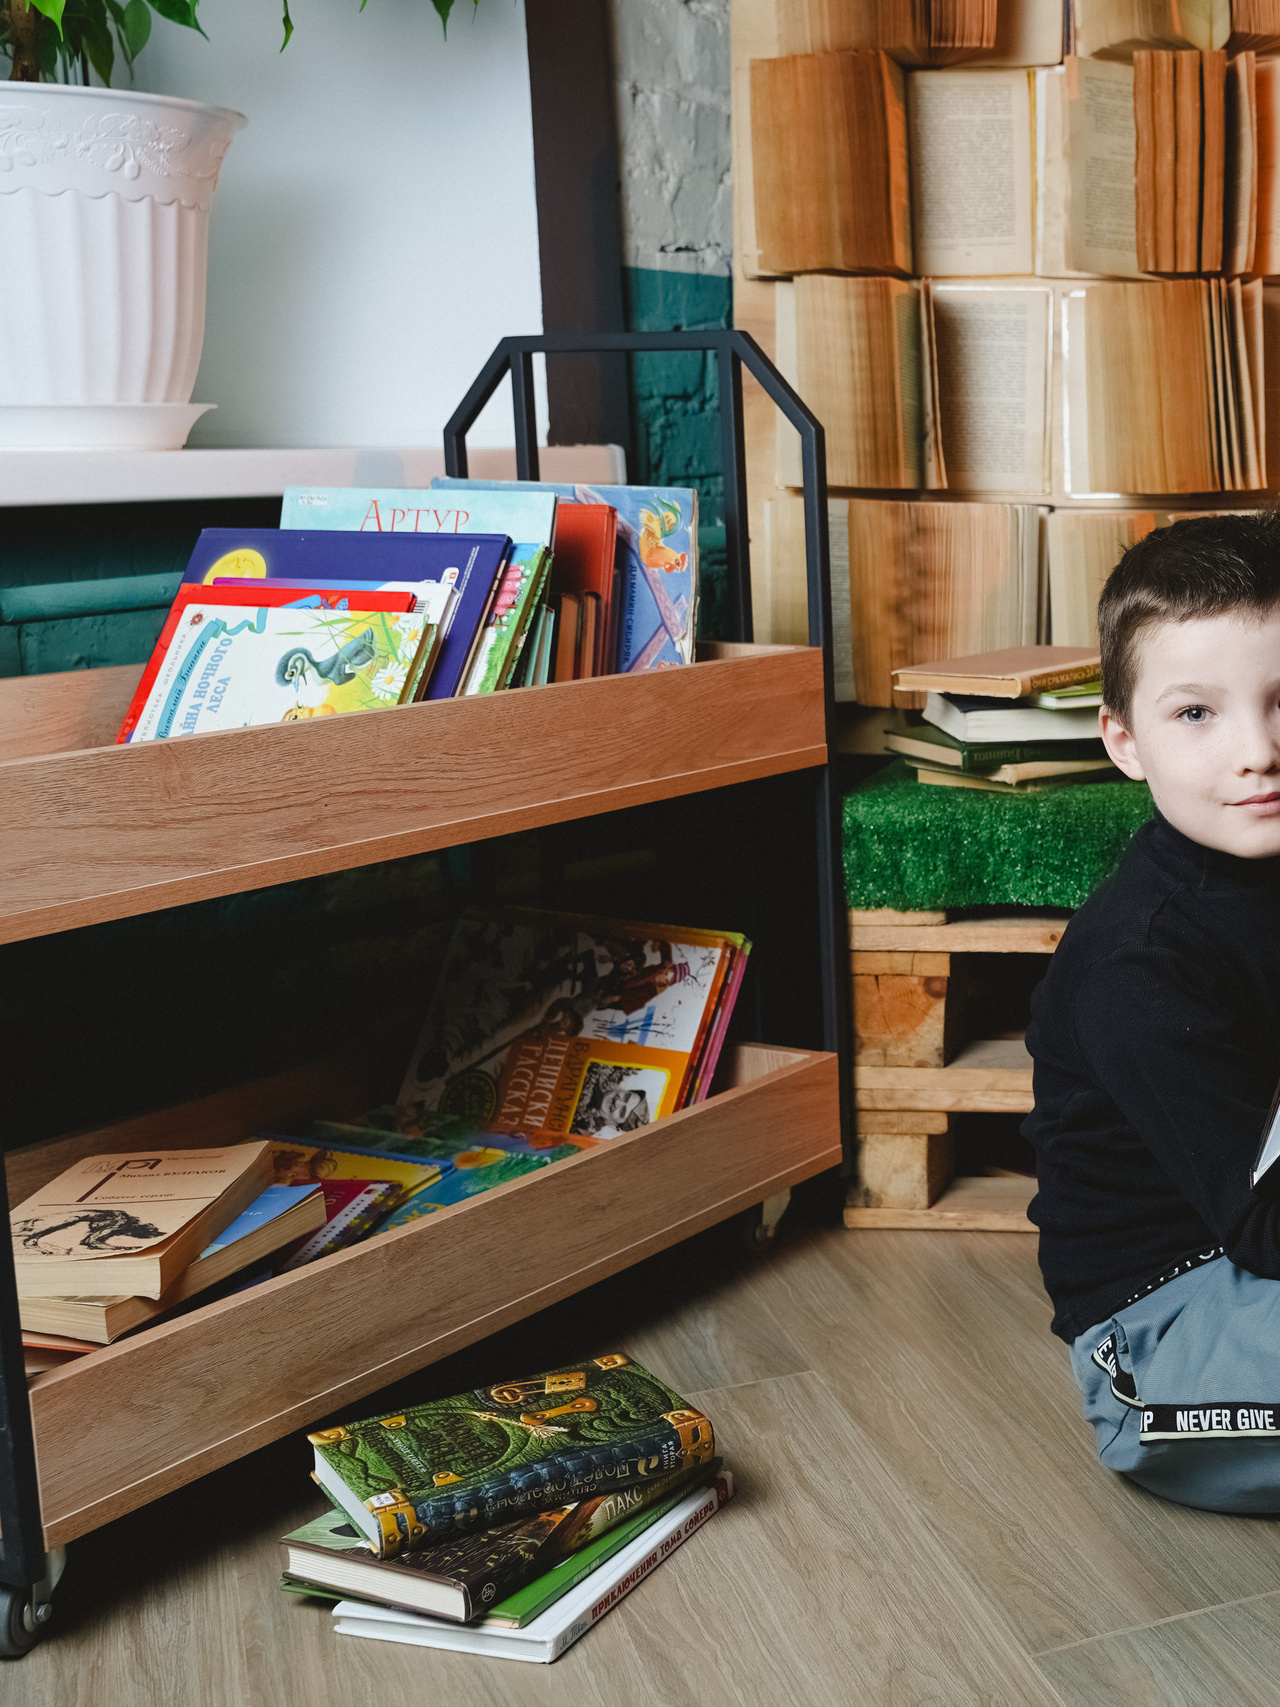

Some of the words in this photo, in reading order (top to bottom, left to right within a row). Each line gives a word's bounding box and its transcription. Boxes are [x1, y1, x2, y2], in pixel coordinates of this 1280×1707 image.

[139, 693, 163, 742] ИБЛИОТЕКА
[163, 634, 187, 686] ШКОЛЬНИКА
[157, 687, 183, 739] Виталий
[179, 640, 206, 687] Бианки
[180, 702, 204, 737] ЙНА
[193, 637, 233, 700] НОЧНОГО
[206, 676, 231, 714] ЛЕСА
[500, 1041, 542, 1128] РАССКАЗ
[522, 1037, 570, 1129] ДЕНИСКИ
[661, 1442, 669, 1470] КНИГА
[1176, 1409, 1232, 1432] NEVER
[1236, 1408, 1276, 1430] GIVE
[604, 1486, 643, 1520] ПАКС
[591, 1552, 658, 1621] ПРИКЛЮЧЕНИЯ
[659, 1529, 682, 1557] ТОМА
[684, 1500, 715, 1535] СОЙЕРА
